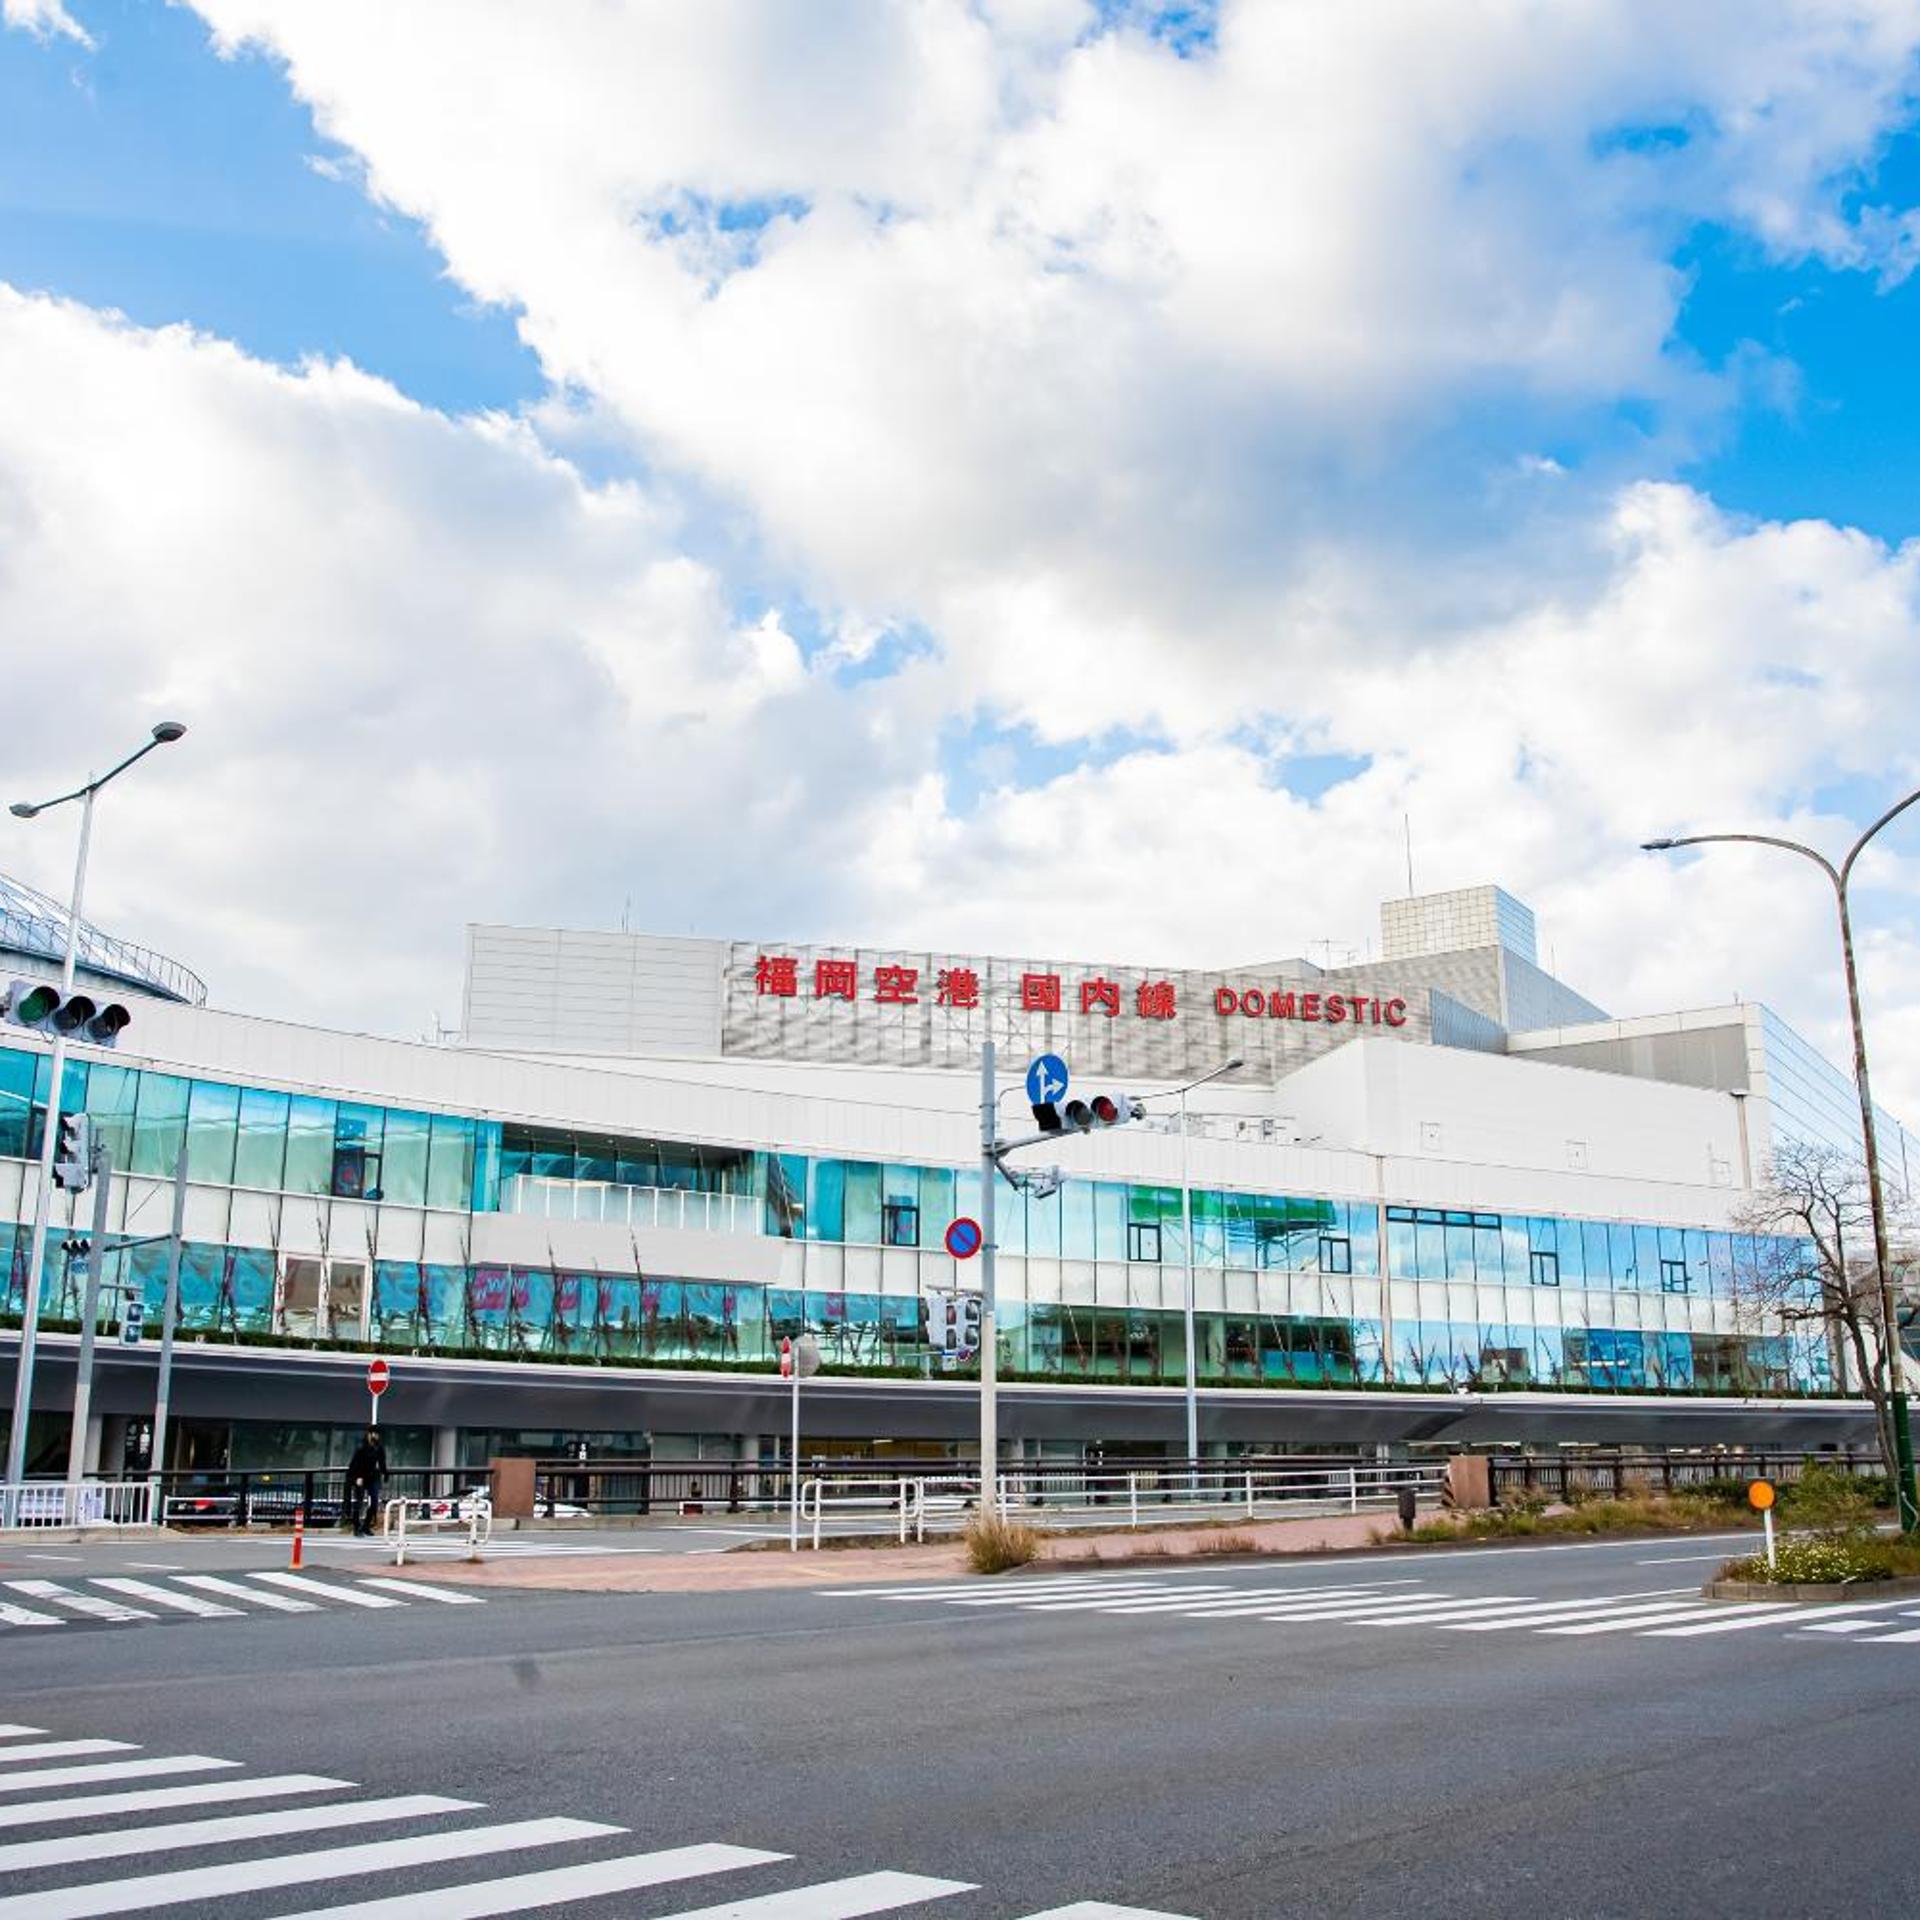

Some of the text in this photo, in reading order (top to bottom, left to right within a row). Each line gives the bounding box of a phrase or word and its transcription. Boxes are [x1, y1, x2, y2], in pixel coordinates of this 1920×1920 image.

[755, 955, 1406, 1026] 福岡空港 国内線 DOMESTIC
